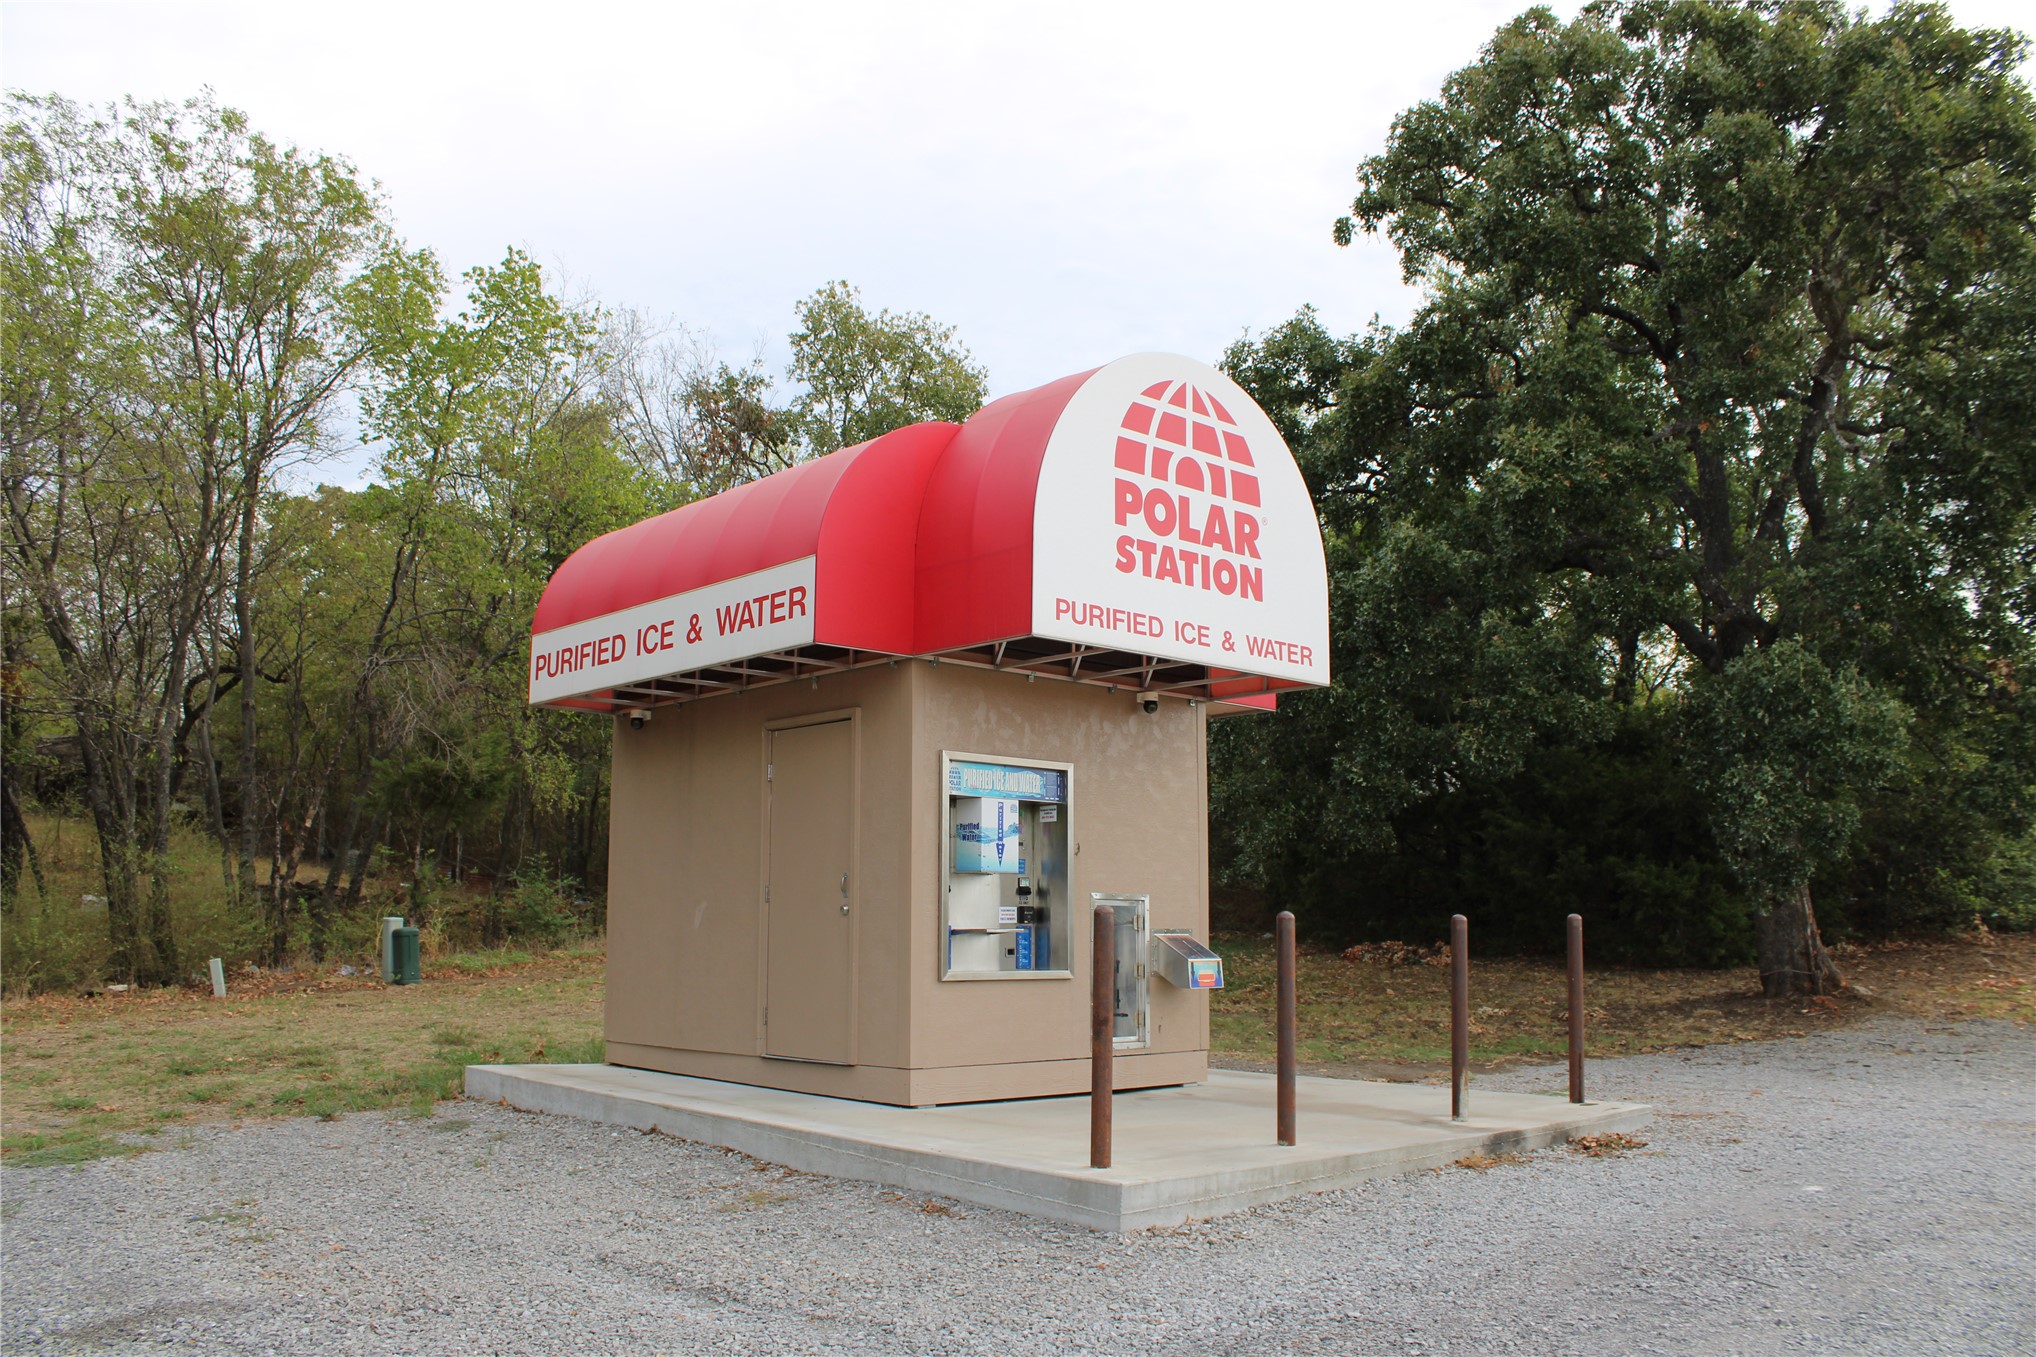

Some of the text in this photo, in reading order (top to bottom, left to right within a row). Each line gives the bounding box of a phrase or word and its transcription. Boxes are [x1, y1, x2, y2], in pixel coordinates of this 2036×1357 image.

[1114, 477, 1262, 560] POLAR
[1115, 535, 1263, 602] STATION
[535, 585, 807, 680] PURIFIED ICE & WATER
[1055, 597, 1313, 667] PURIFIED ICE & WATER
[964, 767, 993, 790] PURIFIED
[993, 768, 1004, 791] ICE
[1005, 770, 1019, 793] AND
[1019, 771, 1041, 794] WATER
[959, 822, 980, 831] Purified
[961, 833, 977, 841] Water
